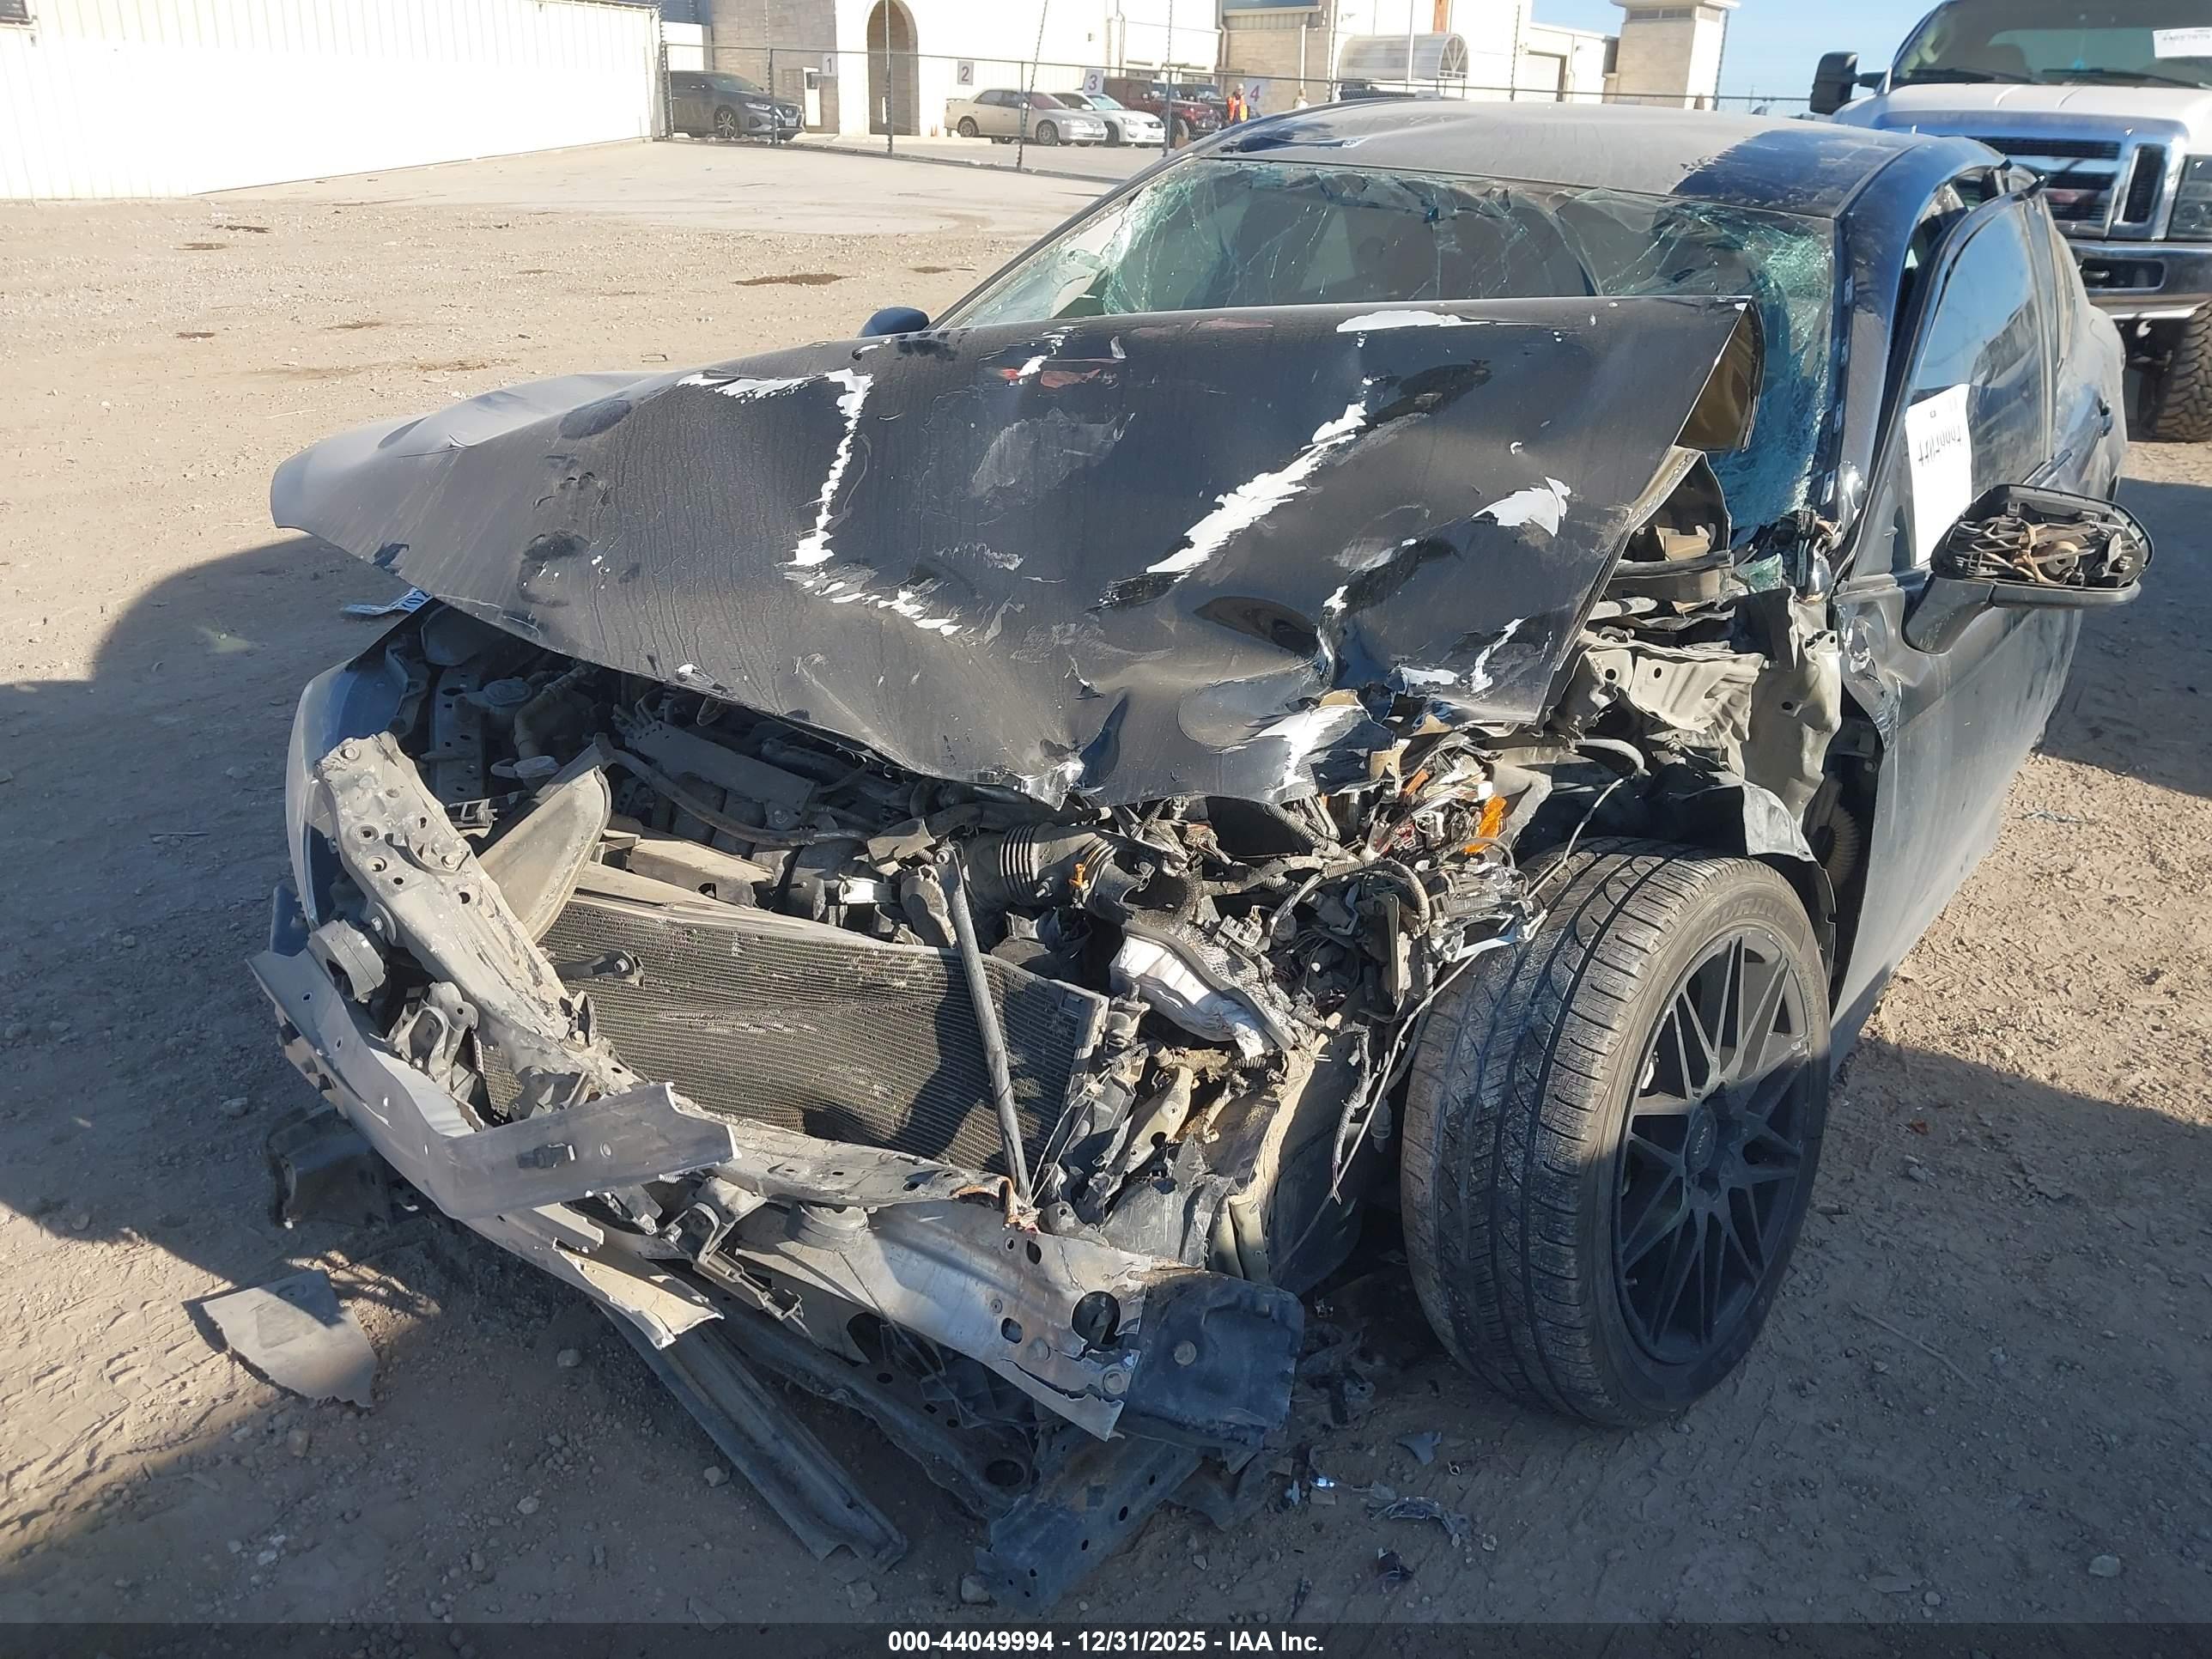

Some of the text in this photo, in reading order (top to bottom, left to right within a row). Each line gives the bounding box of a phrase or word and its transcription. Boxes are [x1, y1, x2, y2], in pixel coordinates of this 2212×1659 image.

[826, 58, 832, 73] 1
[962, 65, 969, 82] 2
[1088, 74, 1097, 91] 3
[1249, 85, 1261, 102] 4
